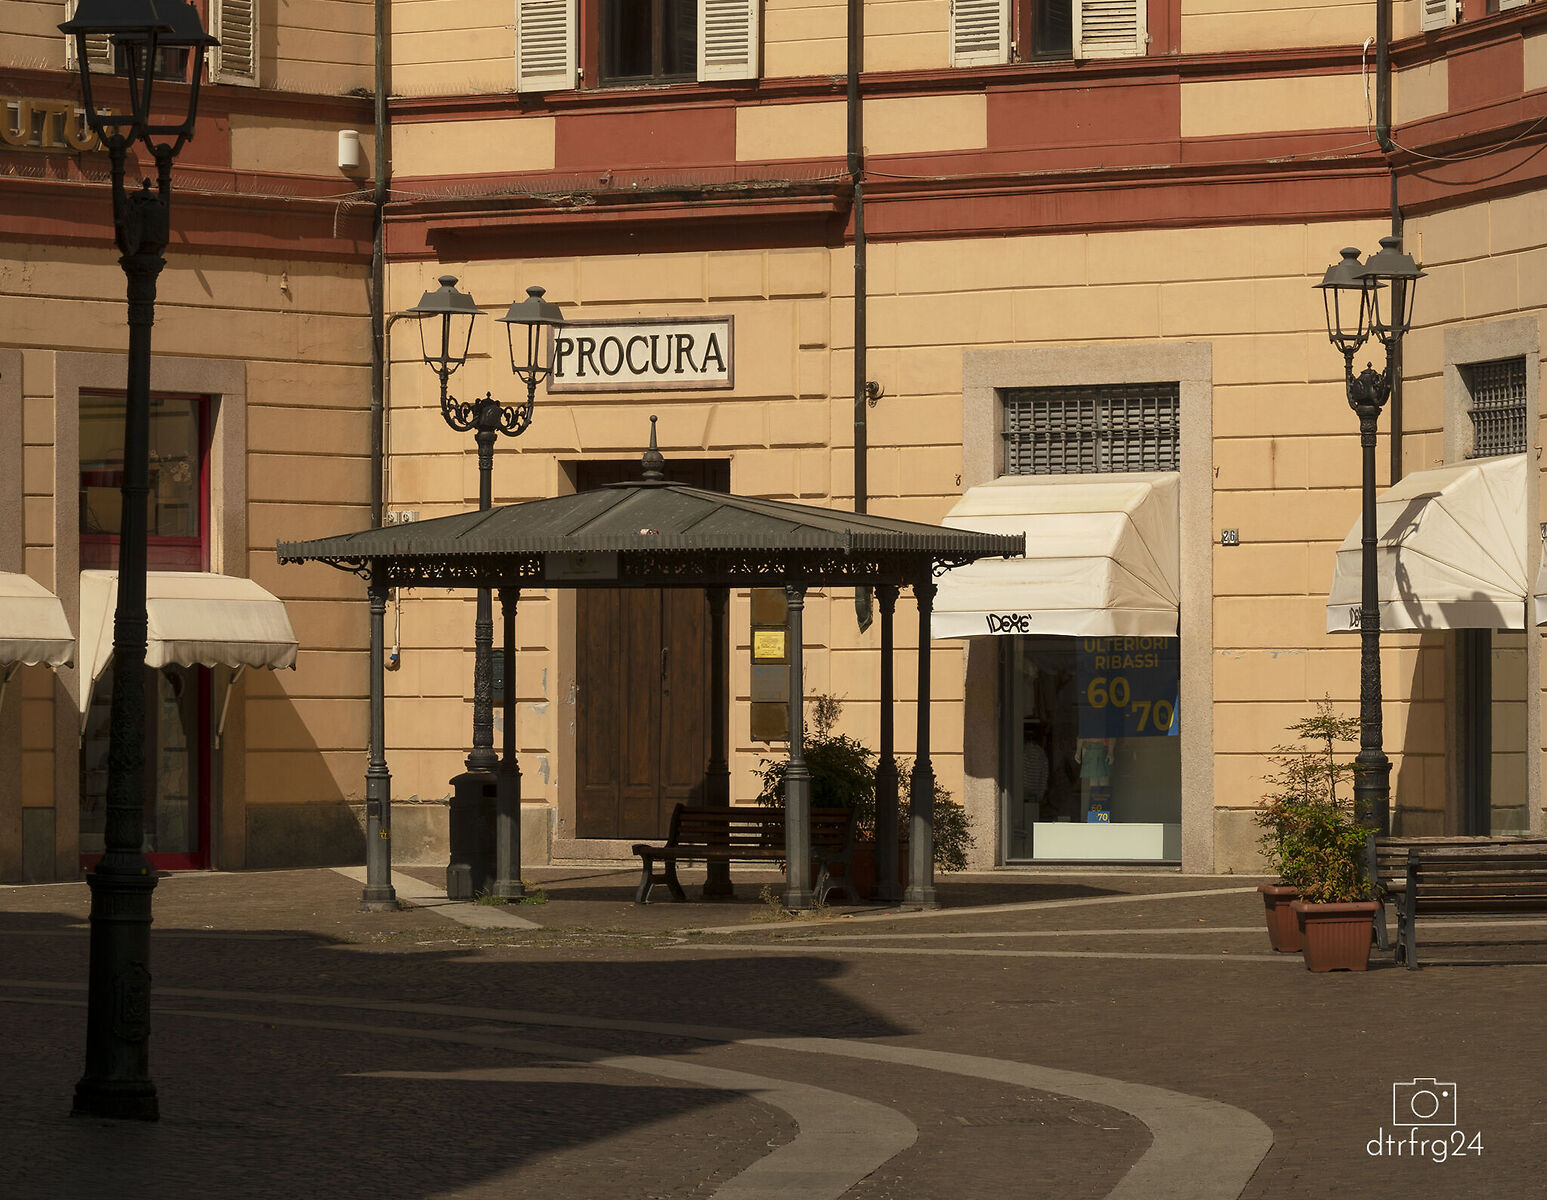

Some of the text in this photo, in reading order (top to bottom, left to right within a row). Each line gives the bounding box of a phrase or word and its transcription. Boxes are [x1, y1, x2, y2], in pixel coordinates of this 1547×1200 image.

[554, 332, 727, 377] PROCURA
[1083, 636, 1169, 653] ULTERIORI
[1095, 653, 1159, 670] RIBASSI
